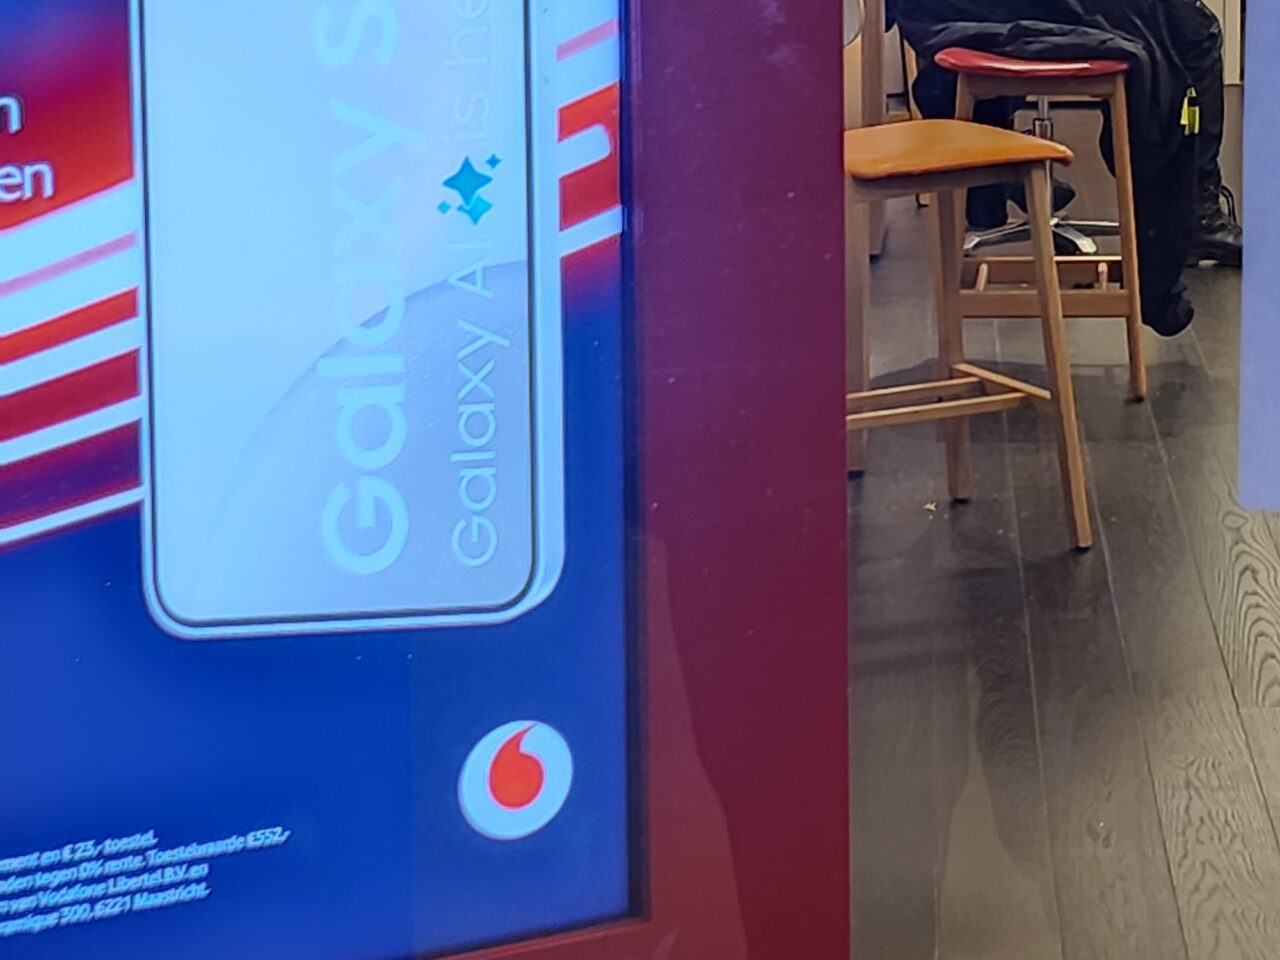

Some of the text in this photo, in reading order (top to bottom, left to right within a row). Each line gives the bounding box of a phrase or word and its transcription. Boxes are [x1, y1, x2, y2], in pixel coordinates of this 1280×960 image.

[443, 87, 490, 143] is
[323, 99, 423, 576] Galaxy
[448, 240, 491, 298] AI
[450, 321, 511, 567] Galaxy
